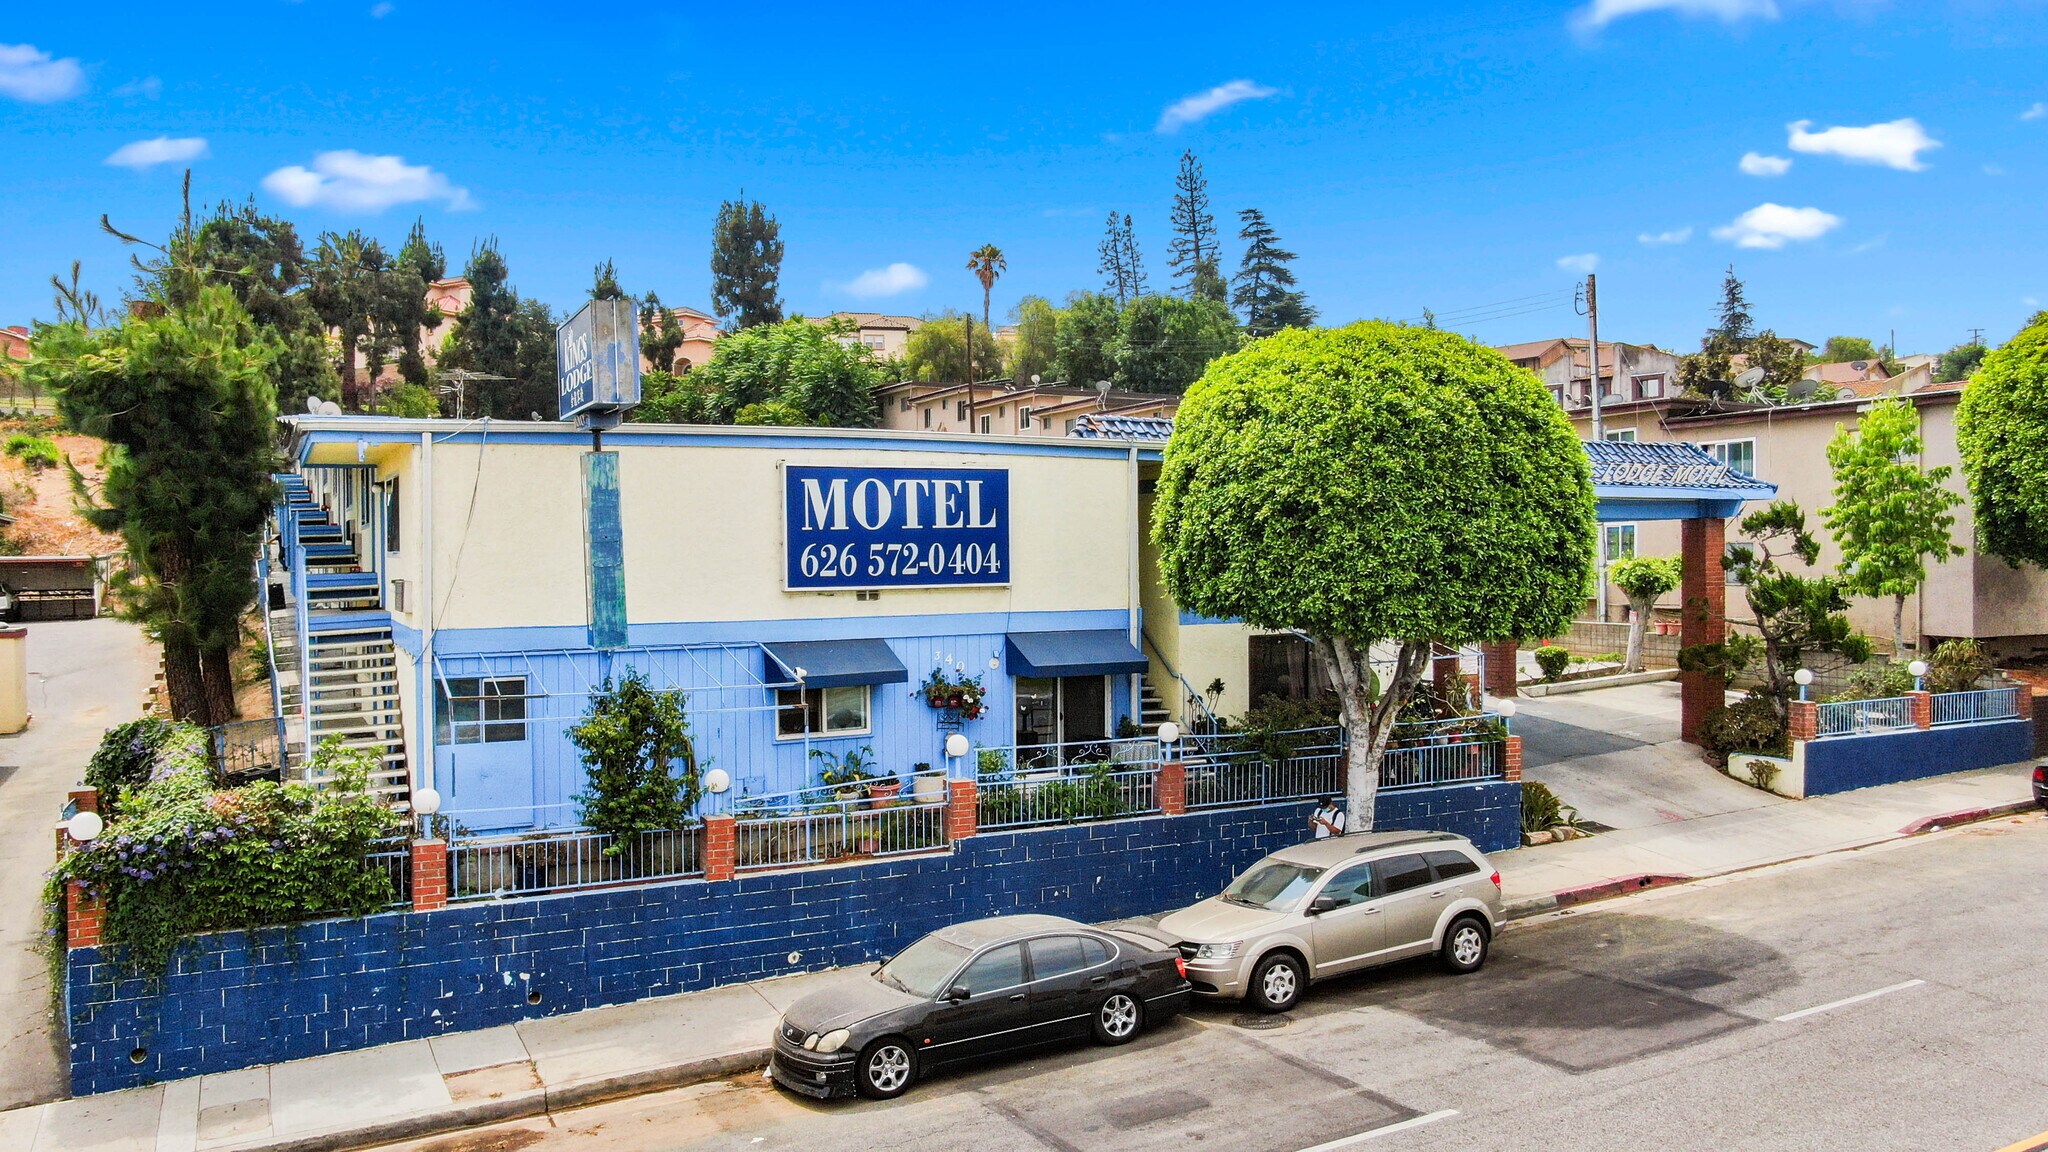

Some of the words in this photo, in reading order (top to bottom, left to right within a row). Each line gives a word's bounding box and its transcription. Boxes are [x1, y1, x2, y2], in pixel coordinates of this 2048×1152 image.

[564, 332, 588, 373] KINGS
[561, 359, 593, 397] LODGE
[1601, 462, 1669, 482] LODGE
[1669, 464, 1728, 483] MOTEL
[800, 477, 997, 531] MOTEL
[800, 543, 858, 578] 626
[867, 542, 1001, 577] 572-0404
[933, 650, 966, 673] 340
